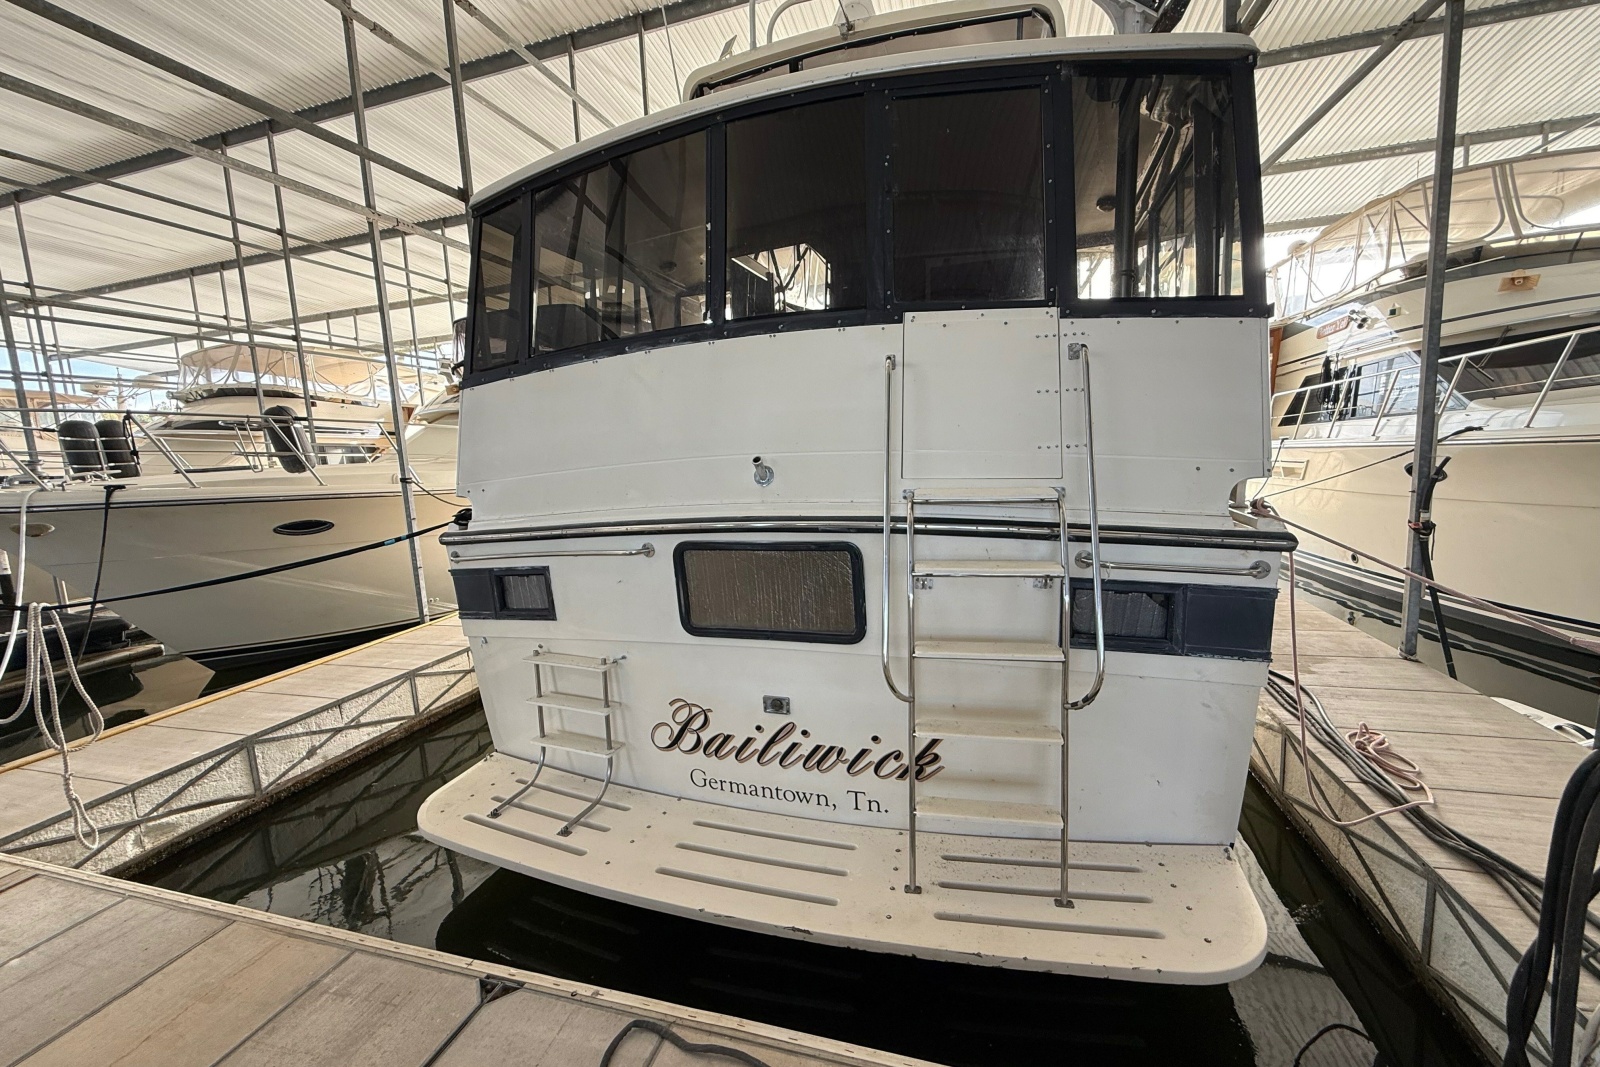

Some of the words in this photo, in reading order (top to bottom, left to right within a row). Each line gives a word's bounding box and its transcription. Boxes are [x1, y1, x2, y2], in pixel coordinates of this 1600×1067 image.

[651, 698, 945, 781] Bailiwick
[690, 768, 837, 811] Germantown,
[847, 790, 889, 814] Tn.
